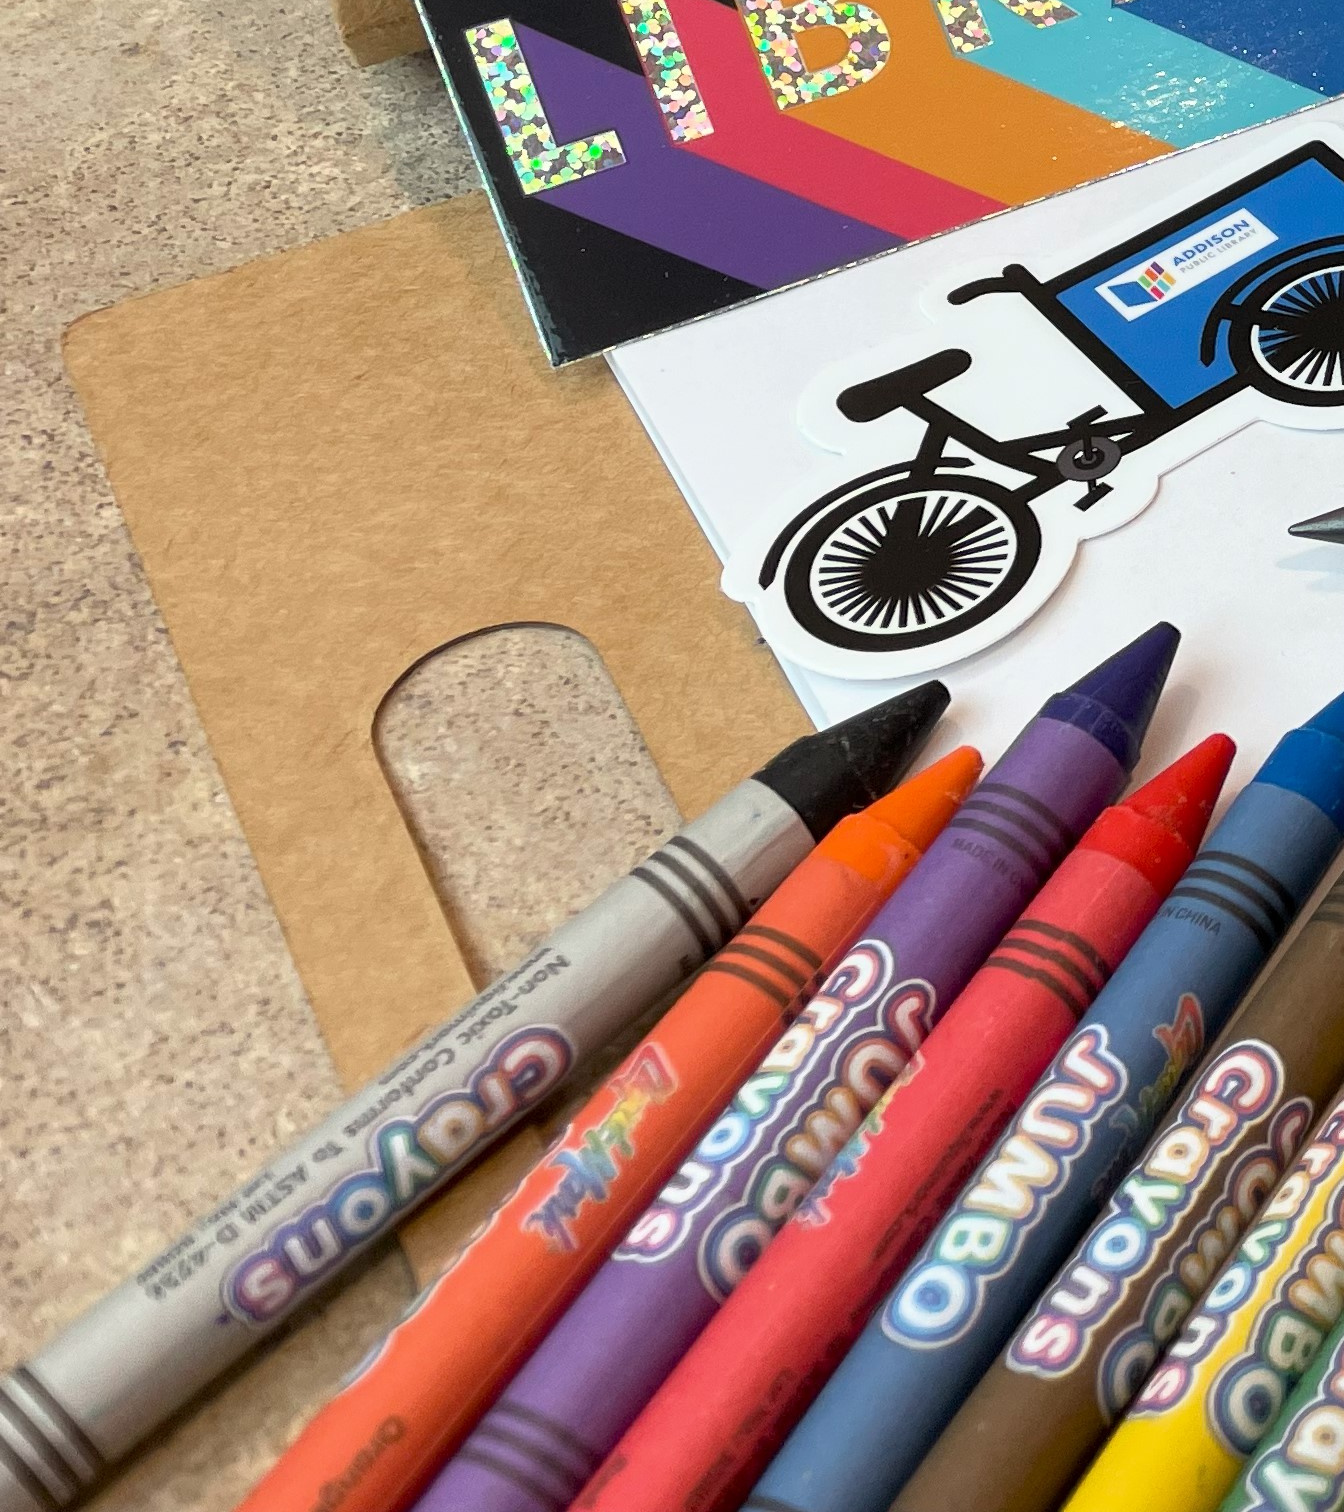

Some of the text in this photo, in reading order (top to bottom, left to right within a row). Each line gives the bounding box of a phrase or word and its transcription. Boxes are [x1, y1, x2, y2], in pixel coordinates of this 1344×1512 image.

[1173, 219, 1250, 267] ADDISON
[1180, 228, 1257, 274] PUBLIC LIBRARY
[454, 950, 572, 1051] Non-Toxic
[1175, 907, 1221, 935] CHINA
[226, 1026, 573, 1324] Crayons
[341, 1042, 459, 1142] Conforms
[619, 941, 892, 1260] Crayons
[704, 981, 937, 1300] JUMBO
[886, 1026, 1127, 1344] JUMBO
[1006, 1041, 1284, 1374] Crayons
